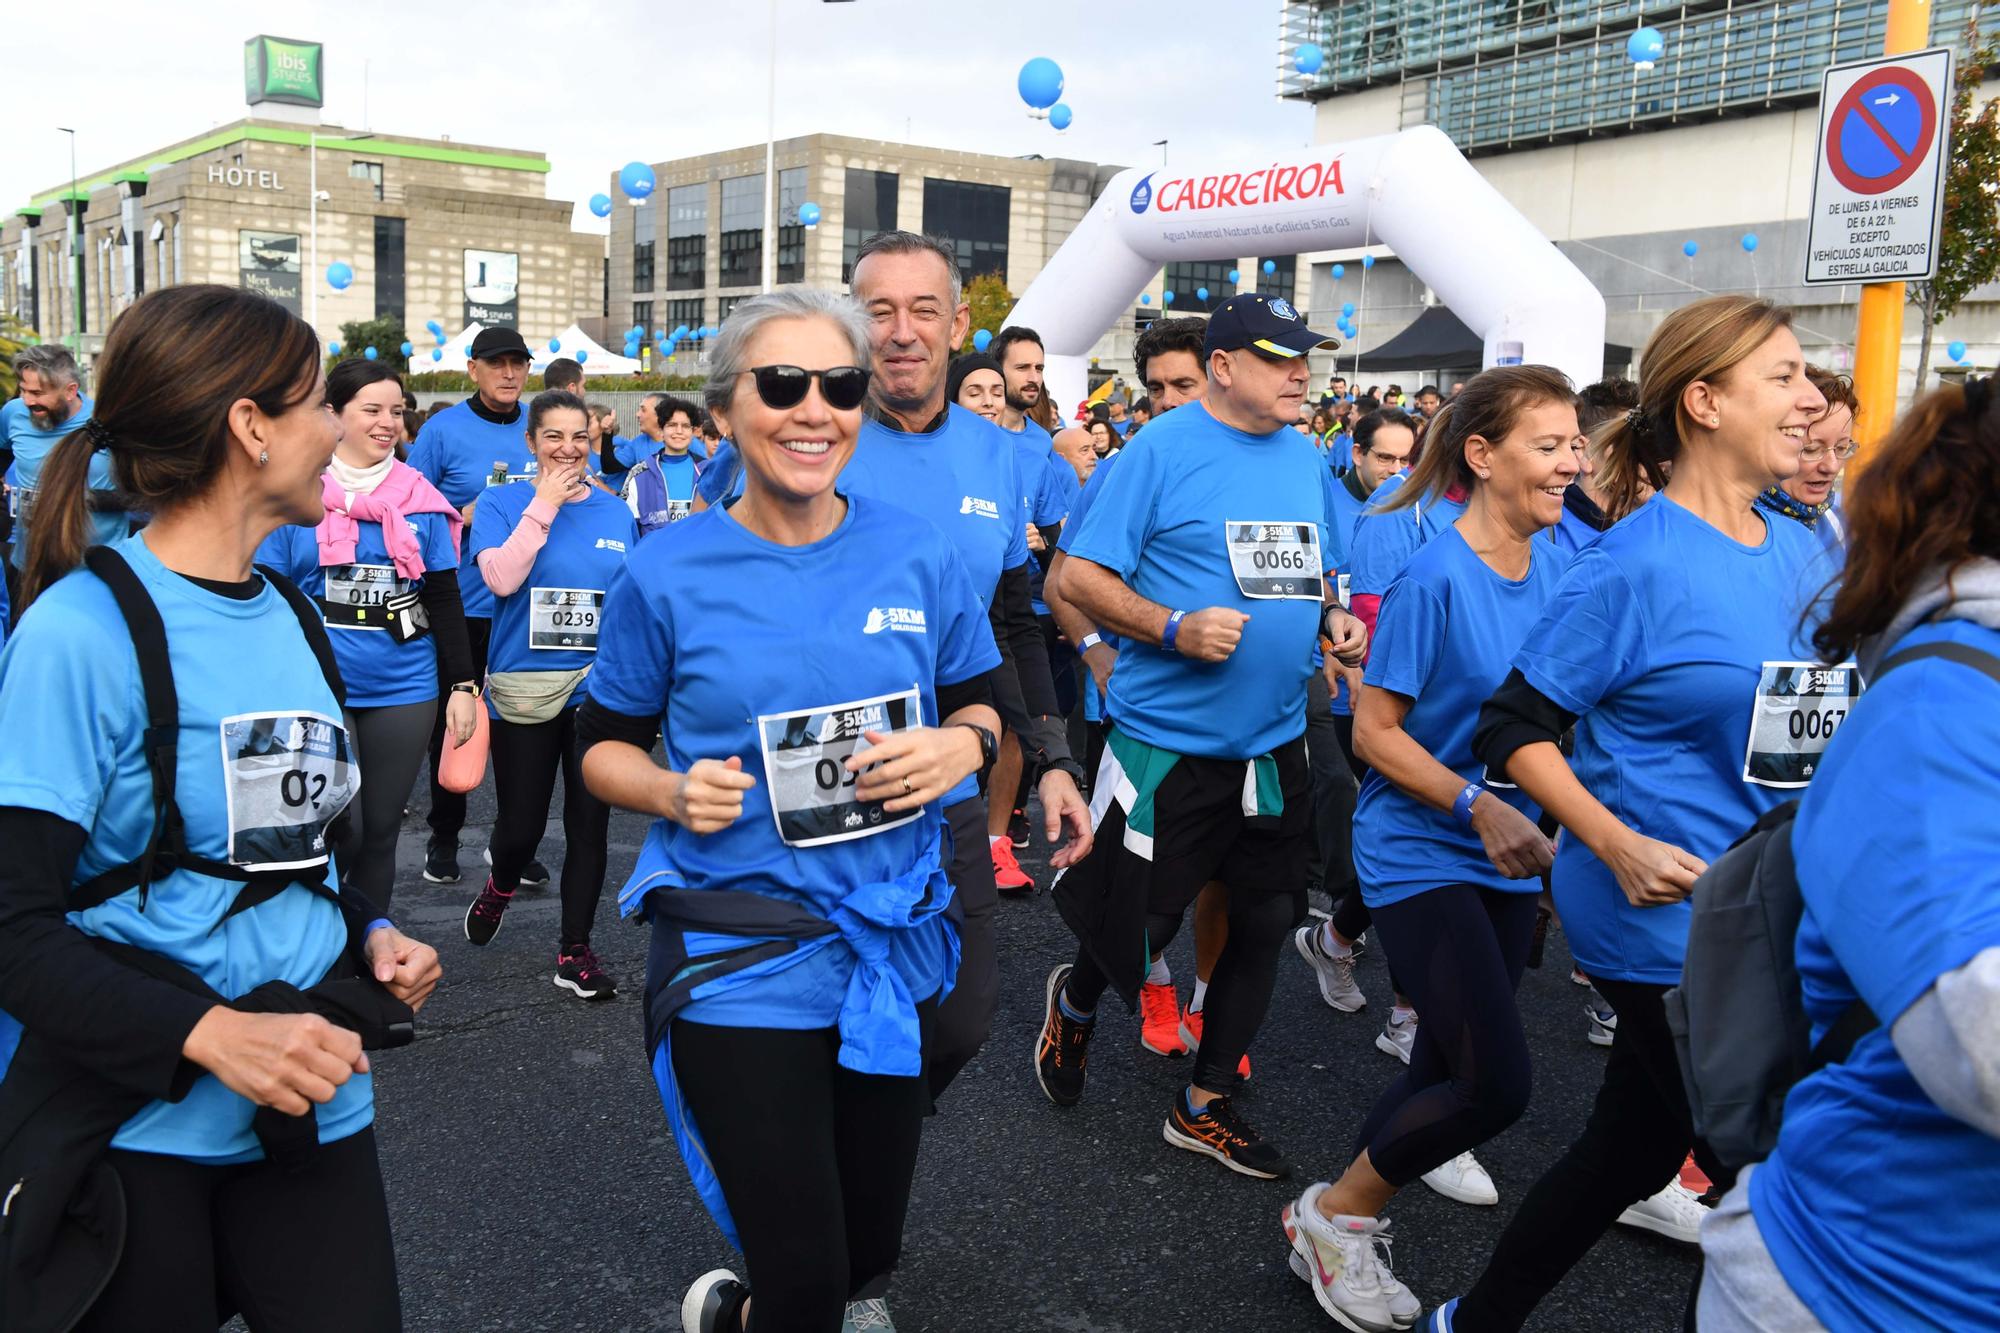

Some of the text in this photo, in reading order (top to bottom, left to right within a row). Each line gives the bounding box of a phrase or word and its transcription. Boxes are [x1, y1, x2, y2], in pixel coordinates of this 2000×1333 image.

[278, 52, 307, 71] ibis
[208, 165, 285, 190] HOTEL
[1156, 152, 1345, 213] CABREÍROÁ
[1829, 196, 1919, 215] DE LUNES A VIERNES
[1163, 216, 1350, 243] Agua Mineral Natural de Galicia Sin Gas
[1847, 214, 1896, 229] DE 6 A 22 h.
[1850, 230, 1890, 244] EXCEPTO
[1813, 242, 1926, 261] VEHÍCULOS AUTORIZADOS
[1828, 260, 1909, 276] ESTRELLA GALICIA
[974, 497, 998, 513] 5KM
[1269, 526, 1294, 536] 5KM
[1253, 550, 1304, 570] 0066
[368, 569, 392, 578] 5KM
[569, 592, 592, 601] 5KM
[552, 611, 594, 627] 0239
[888, 607, 926, 625] 5KM
[1815, 670, 1846, 685] 5KM
[844, 706, 882, 728] 5KM
